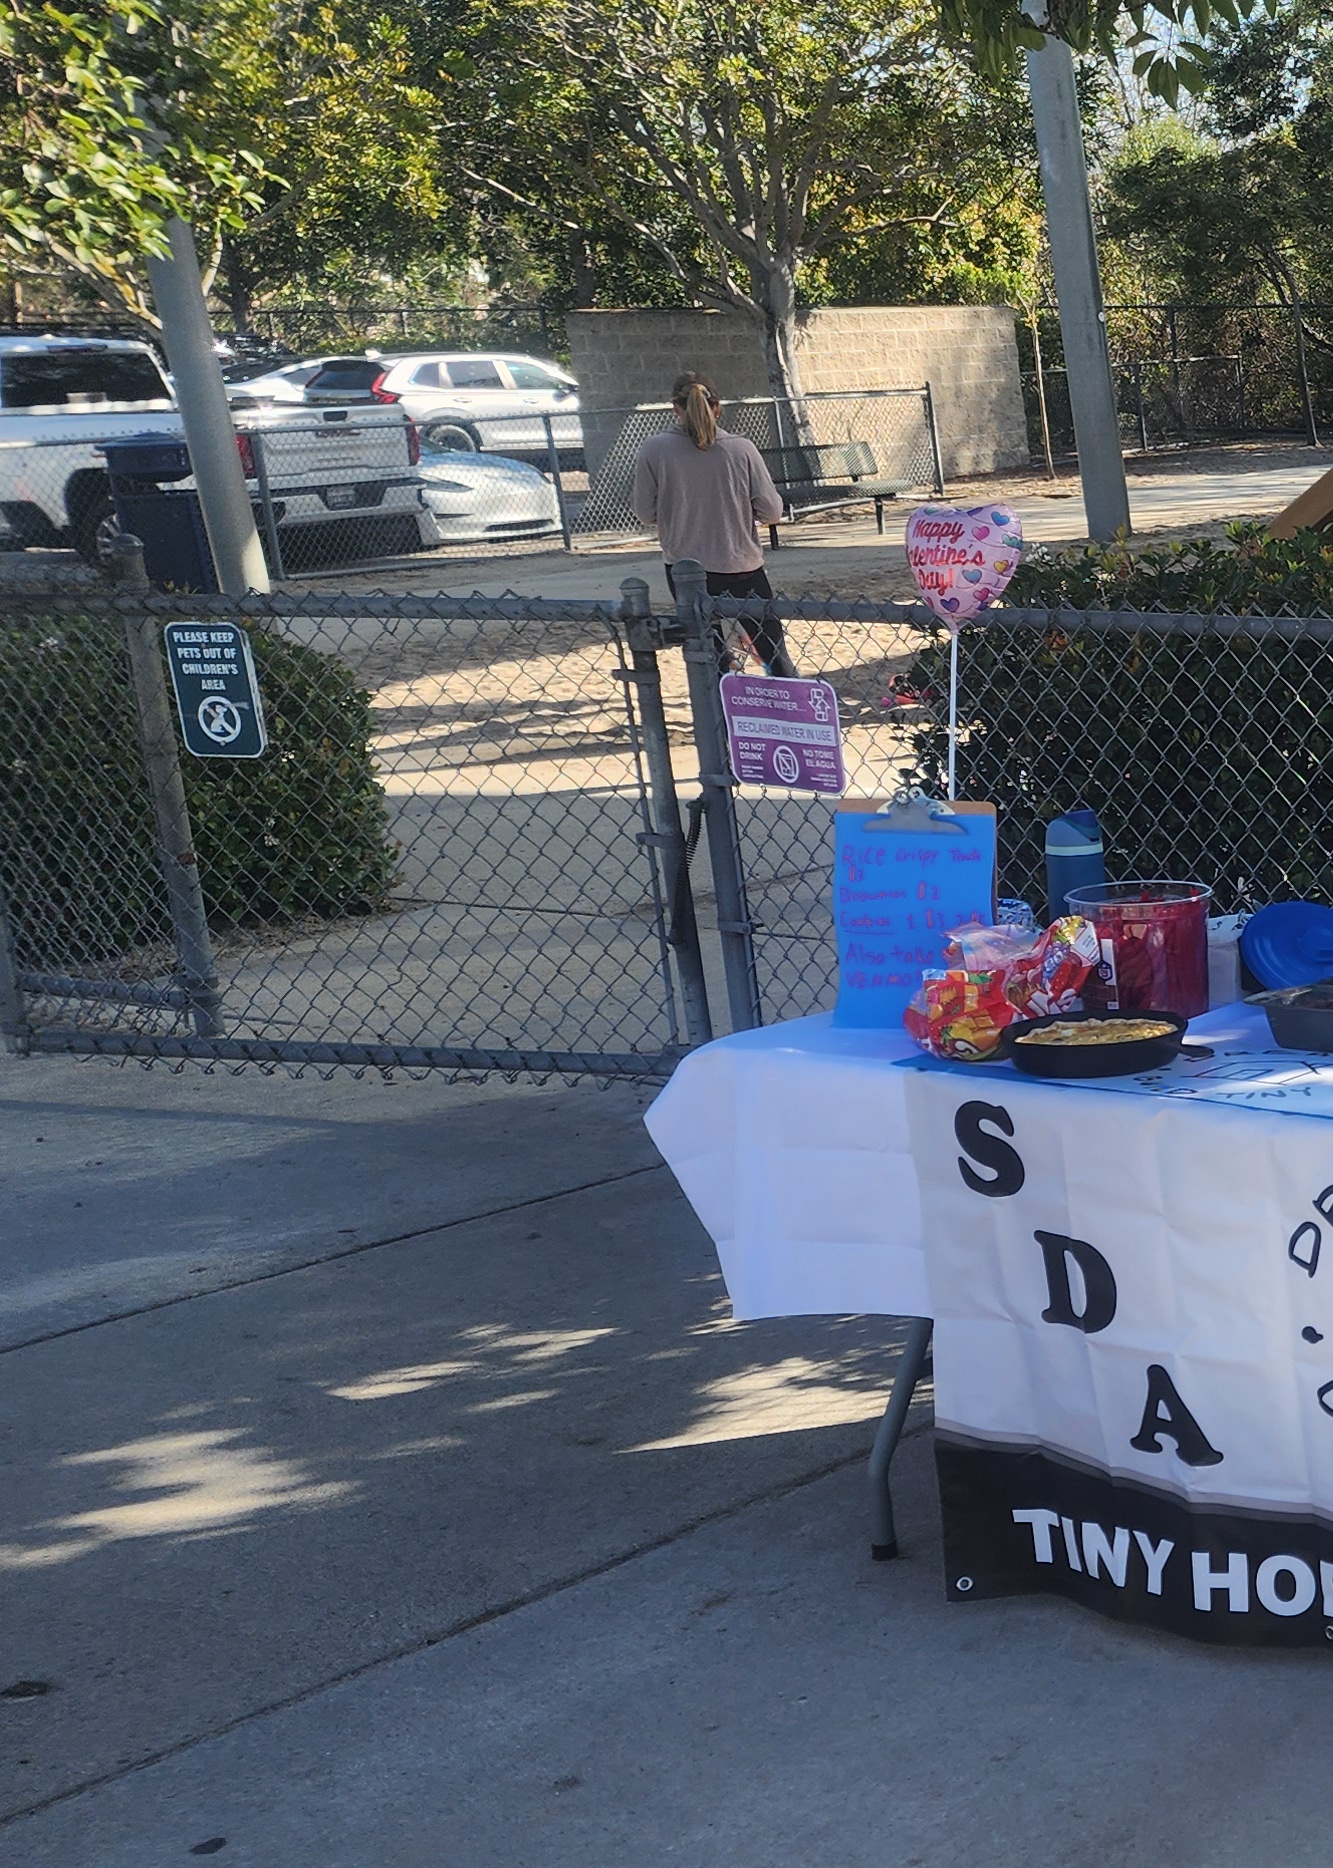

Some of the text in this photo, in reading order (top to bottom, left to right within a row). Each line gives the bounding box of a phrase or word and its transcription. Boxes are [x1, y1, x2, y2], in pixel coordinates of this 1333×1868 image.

[912, 519, 965, 544] Happy
[918, 568, 954, 596] Day!
[173, 632, 234, 643] PLEASE KEEP
[177, 648, 237, 659] PETS OUT OF
[182, 663, 238, 675] CHILDREN'S
[201, 679, 226, 690] AREA
[745, 686, 790, 699] IN ORDER TO
[731, 696, 774, 708] CONSERVE
[737, 721, 833, 742] RECLAIMED WATER IN USE
[739, 741, 766, 751] DO NOT
[740, 751, 763, 761] DRINK
[803, 749, 814, 758] NO
[806, 759, 837, 769] EL AGUA
[845, 941, 885, 964] Also
[1216, 1086, 1312, 1100] TINY
[1011, 1508, 1176, 1597] TINY
